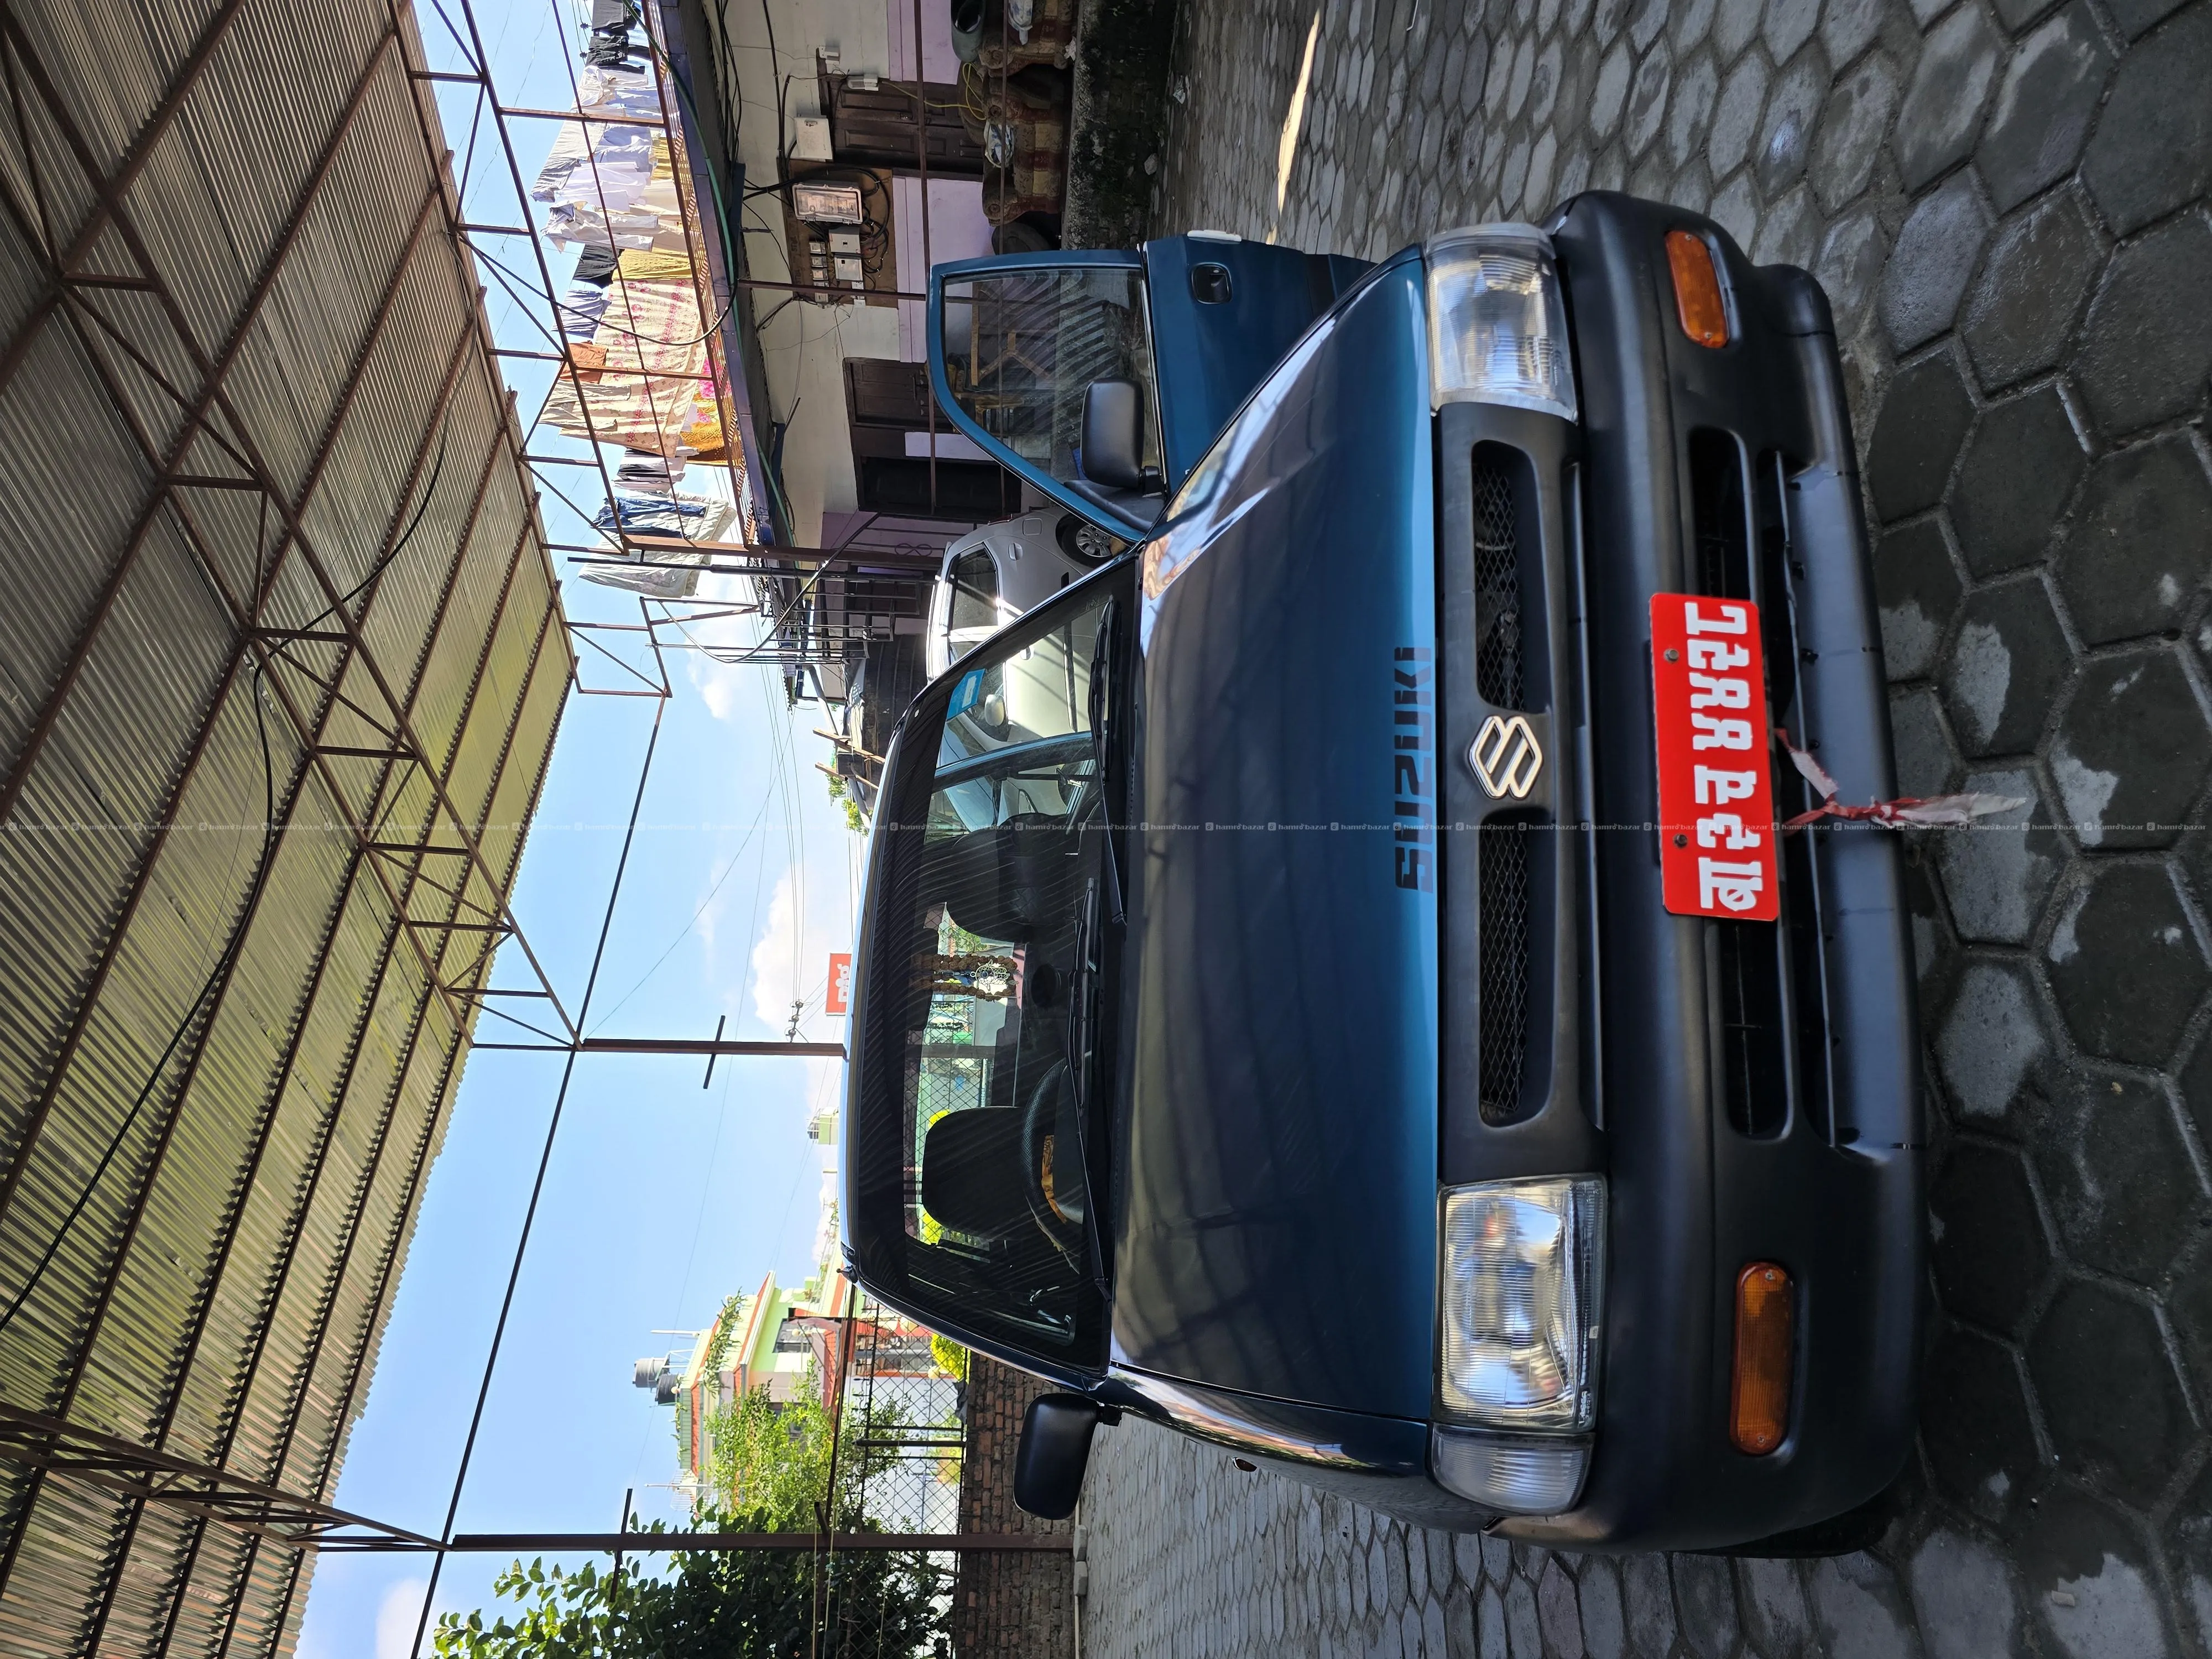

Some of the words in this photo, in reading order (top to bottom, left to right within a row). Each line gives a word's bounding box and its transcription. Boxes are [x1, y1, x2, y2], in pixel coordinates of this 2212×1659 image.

[1684, 601, 1753, 750] ४४२८
[1394, 647, 1433, 894] SUZUKI
[1694, 765, 1756, 805] च
[1696, 813, 1761, 850] ३
[1697, 857, 1763, 911] बा
